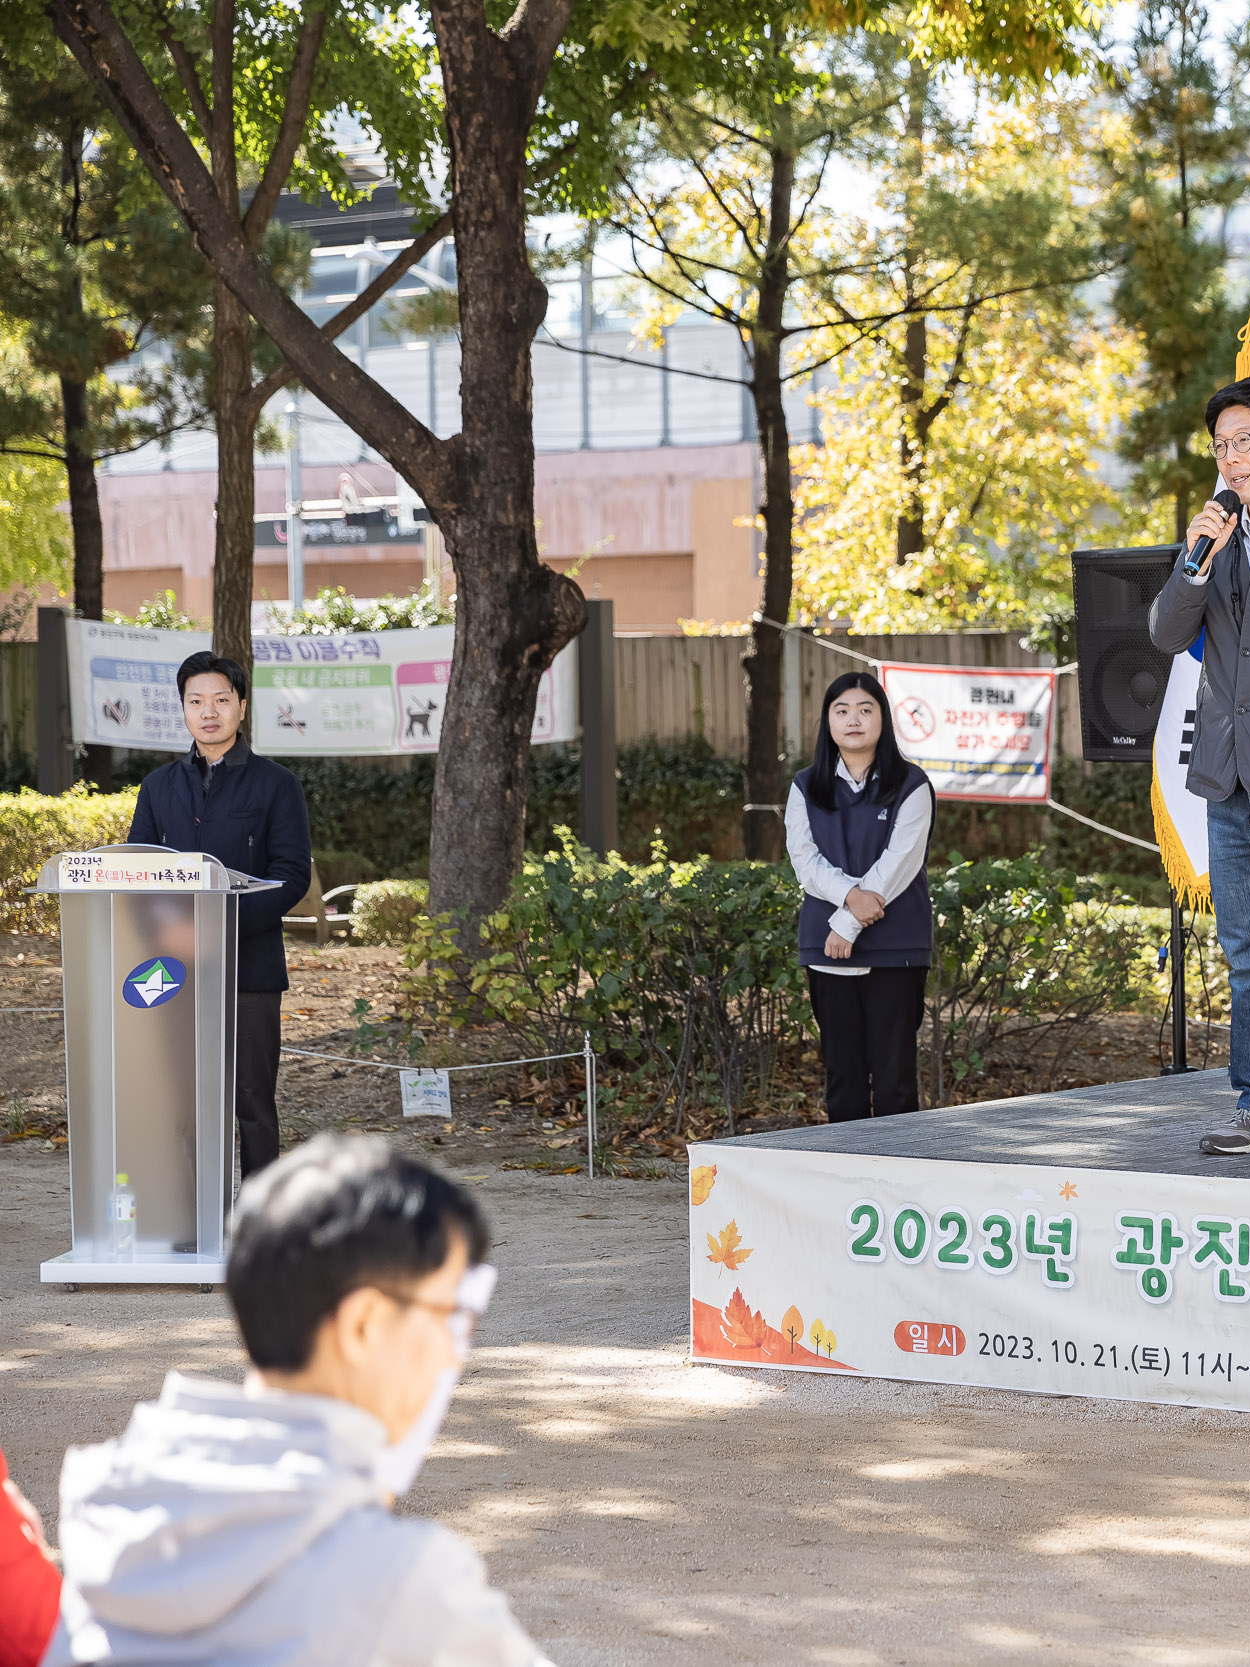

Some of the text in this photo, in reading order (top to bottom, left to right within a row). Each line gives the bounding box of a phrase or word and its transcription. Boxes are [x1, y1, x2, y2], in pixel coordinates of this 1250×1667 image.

[67, 856, 102, 866] 2023년
[67, 869, 91, 883] 광진
[150, 869, 200, 883] 가족축제
[849, 1203, 1078, 1283] 2023년
[1115, 1215, 1250, 1298] 광진
